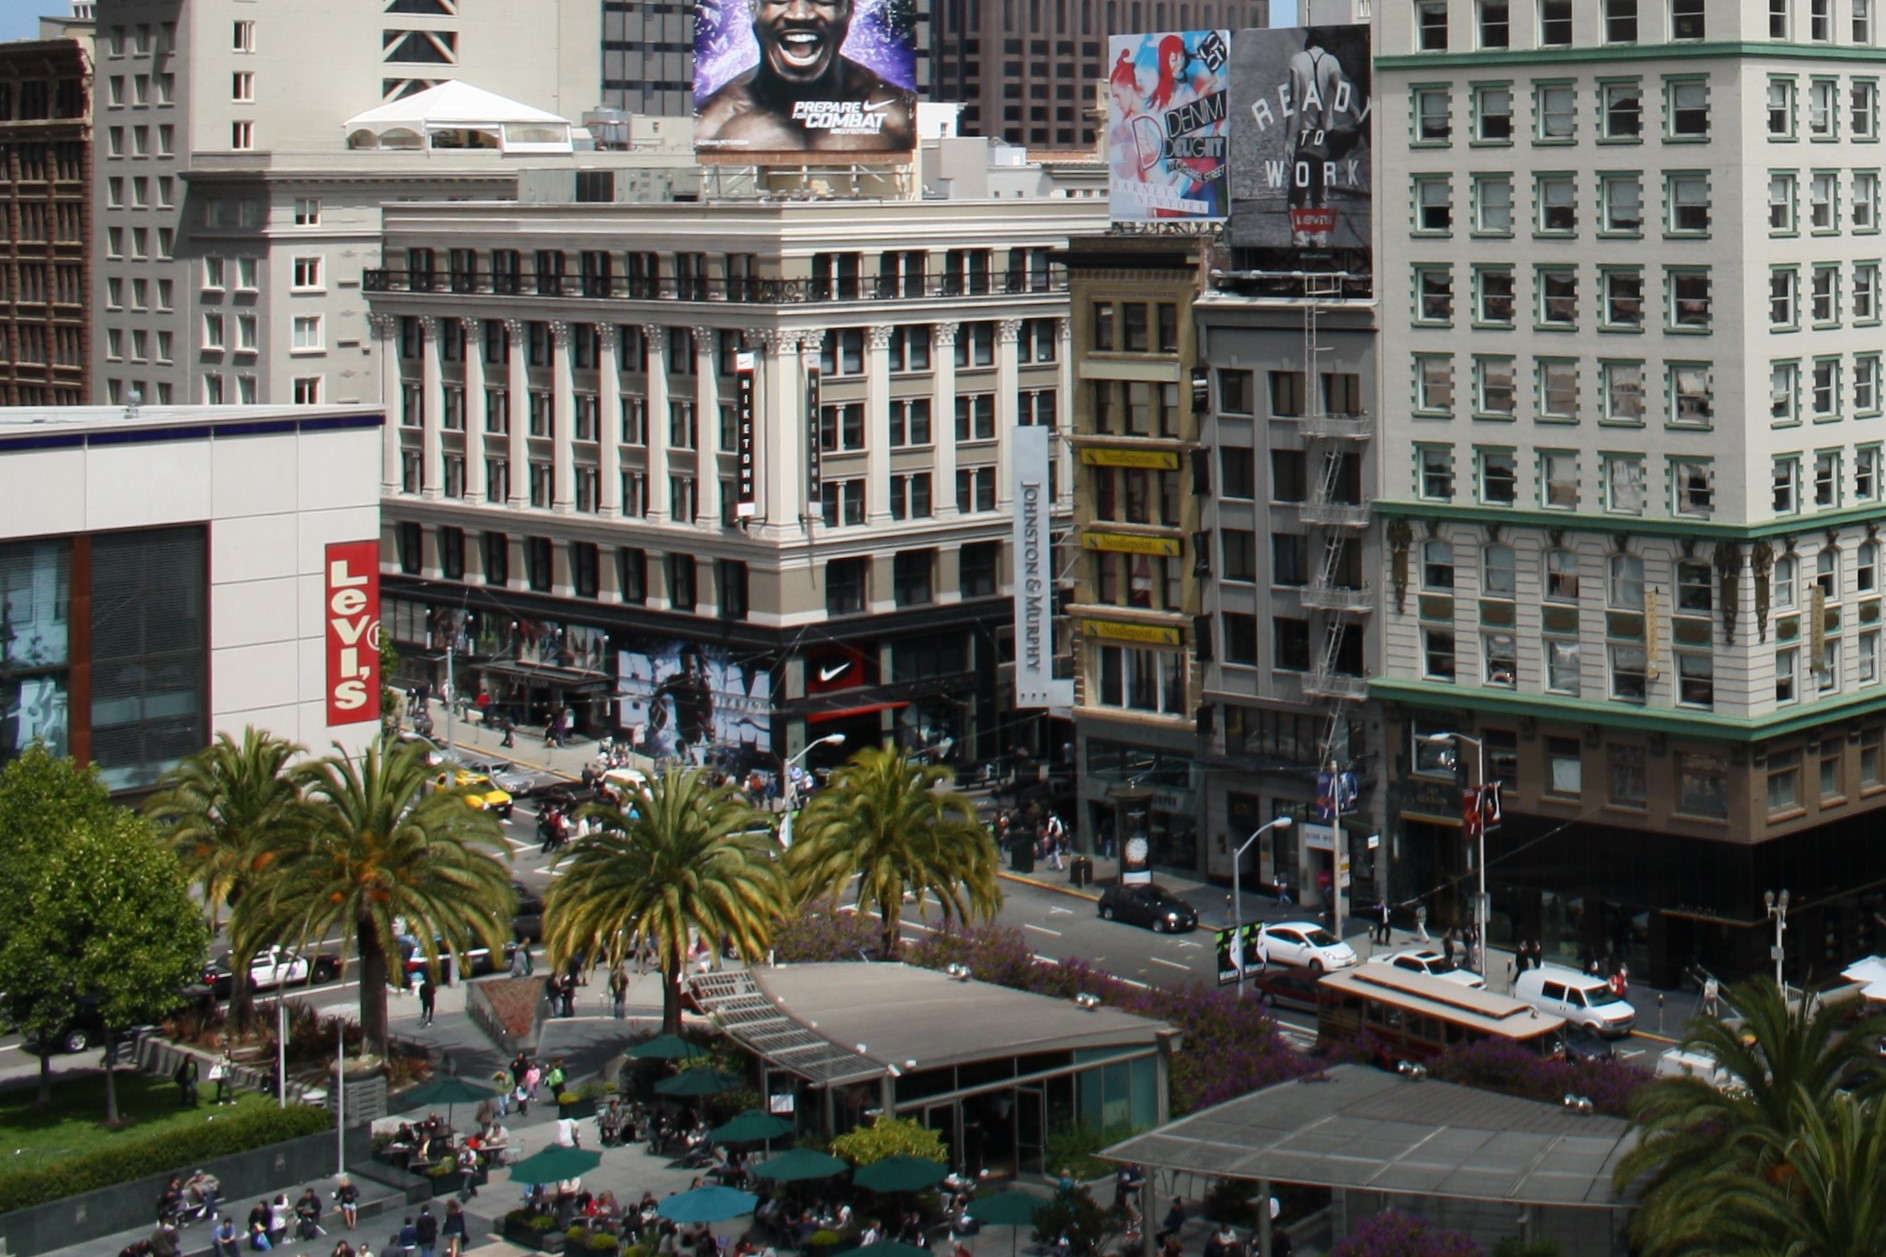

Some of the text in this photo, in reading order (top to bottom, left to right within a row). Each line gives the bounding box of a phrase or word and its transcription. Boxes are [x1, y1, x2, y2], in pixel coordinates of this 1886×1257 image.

[793, 101, 862, 113] PREPARE
[1166, 93, 1224, 138] DENIM
[805, 112, 888, 129] COMBAT
[1164, 137, 1224, 158] DELIGHT
[1301, 130, 1325, 146] TO
[1265, 160, 1359, 187] WORK
[742, 379, 751, 494] NIKETOWN
[1020, 481, 1042, 673] JOHNSTON & MURPHY
